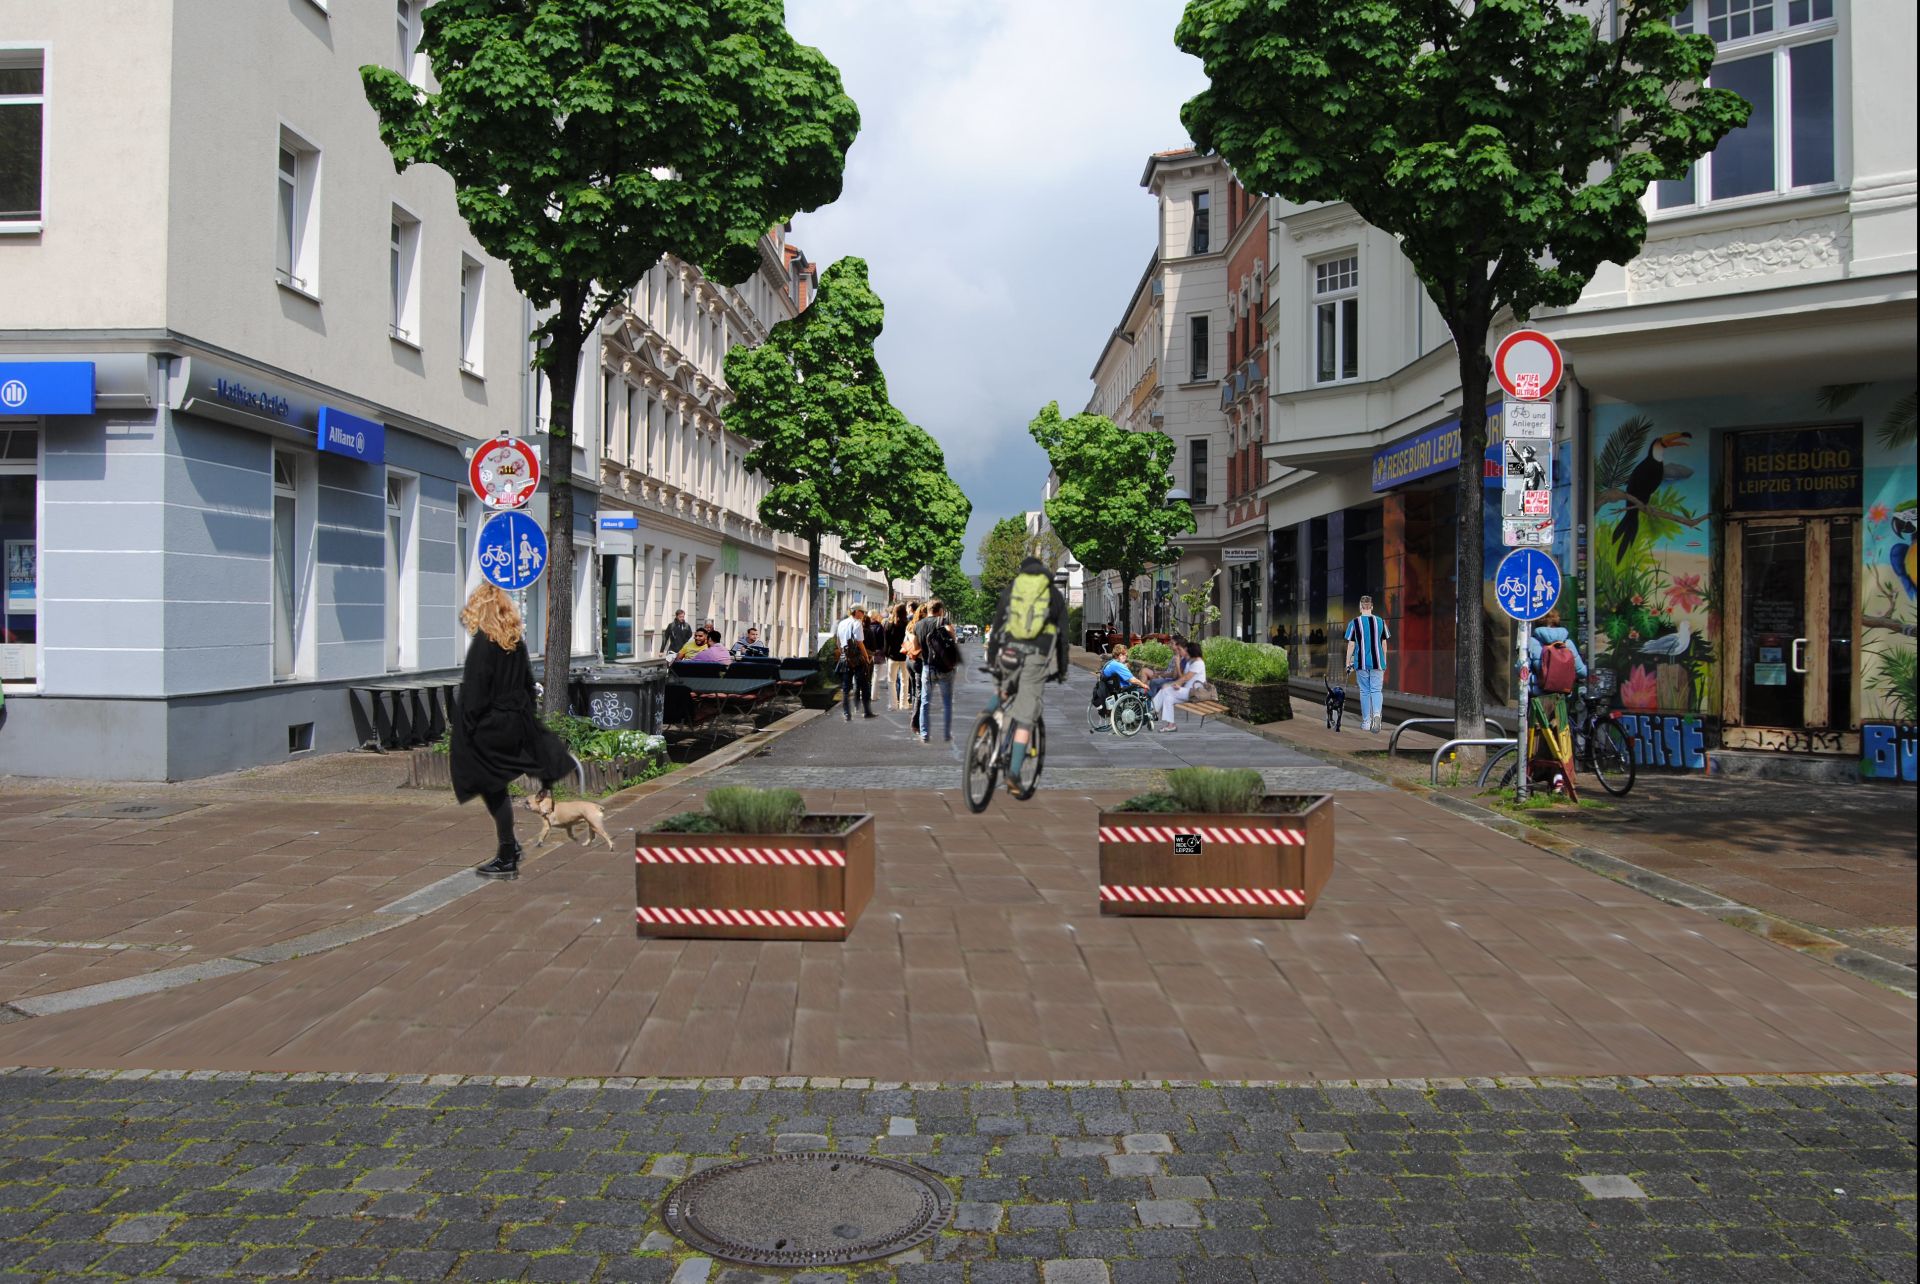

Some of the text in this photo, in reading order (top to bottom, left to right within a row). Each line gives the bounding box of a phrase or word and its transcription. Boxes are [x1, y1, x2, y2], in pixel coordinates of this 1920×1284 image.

[217, 378, 256, 408] Mathias
[1512, 420, 1543, 428] Anlieger
[329, 426, 355, 448] Allianz
[1386, 439, 1431, 480] REISEBÜRO
[1433, 427, 1462, 464] LEIPZI
[1744, 448, 1850, 473] REISEBÜRO
[1739, 475, 1857, 494] LEIPZIG TOURIST
